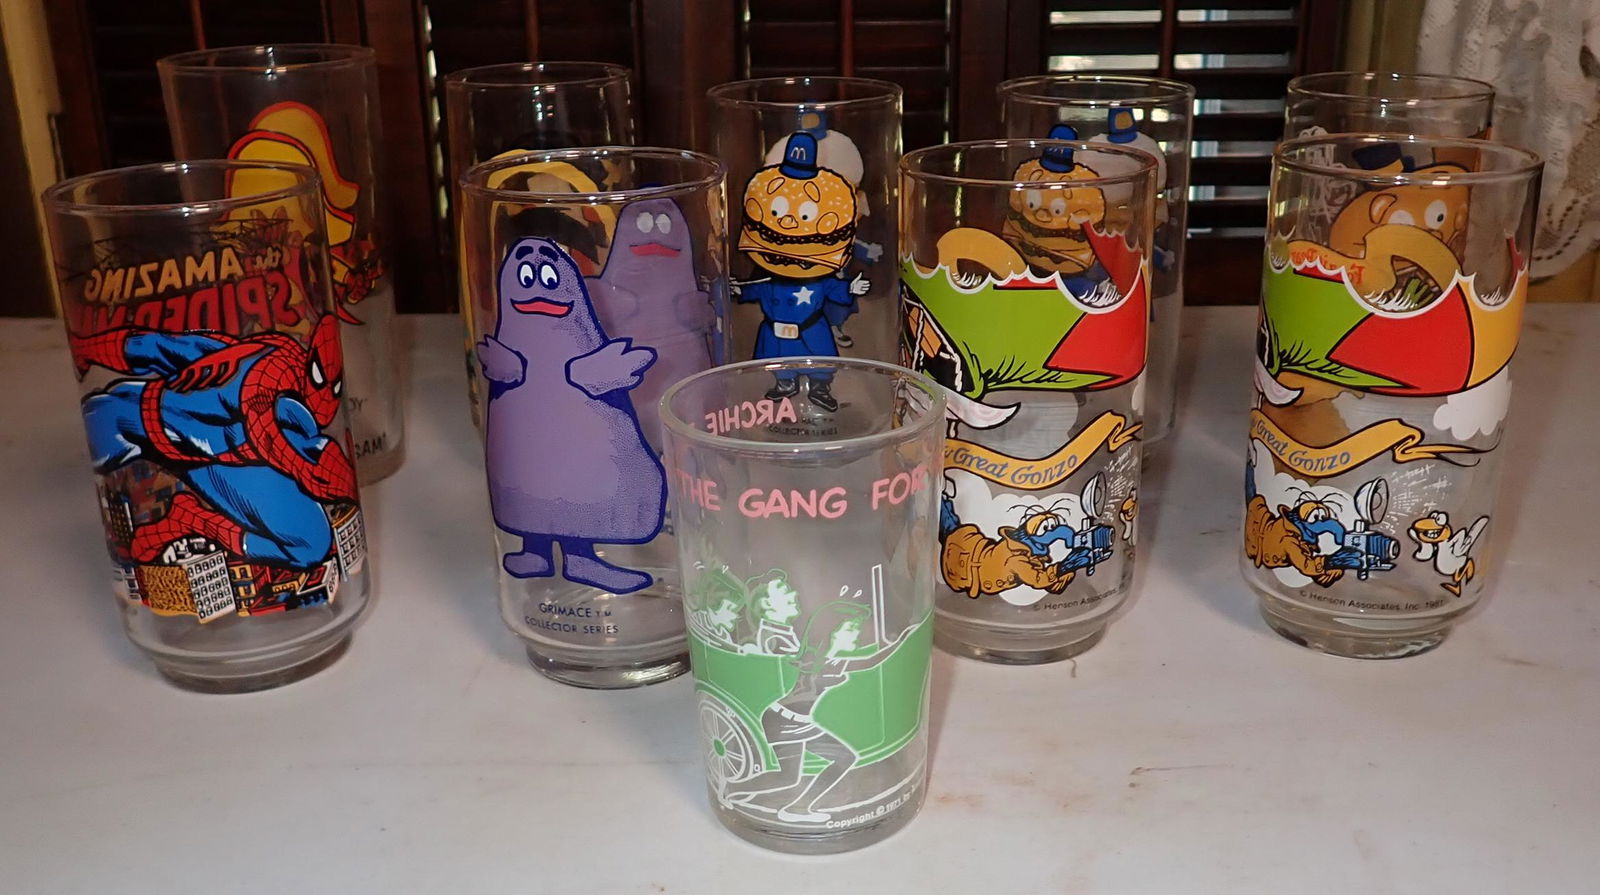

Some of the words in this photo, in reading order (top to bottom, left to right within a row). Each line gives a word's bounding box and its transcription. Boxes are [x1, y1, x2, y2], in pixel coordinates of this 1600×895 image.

[1256, 419, 1289, 457] Great
[1288, 451, 1351, 473] Gonzo
[953, 447, 1008, 478] Great
[1010, 455, 1078, 485] Gonzo
[676, 469, 721, 511] THE
[738, 486, 848, 519] GANG
[871, 463, 929, 511] FOR
[1044, 600, 1078, 610] Henson
[1309, 592, 1345, 607] Henson
[539, 602, 592, 618] GRIMACE
[524, 615, 578, 633] COLLECTOR
[584, 624, 619, 634] SERIES
[826, 810, 874, 829] Copyright
